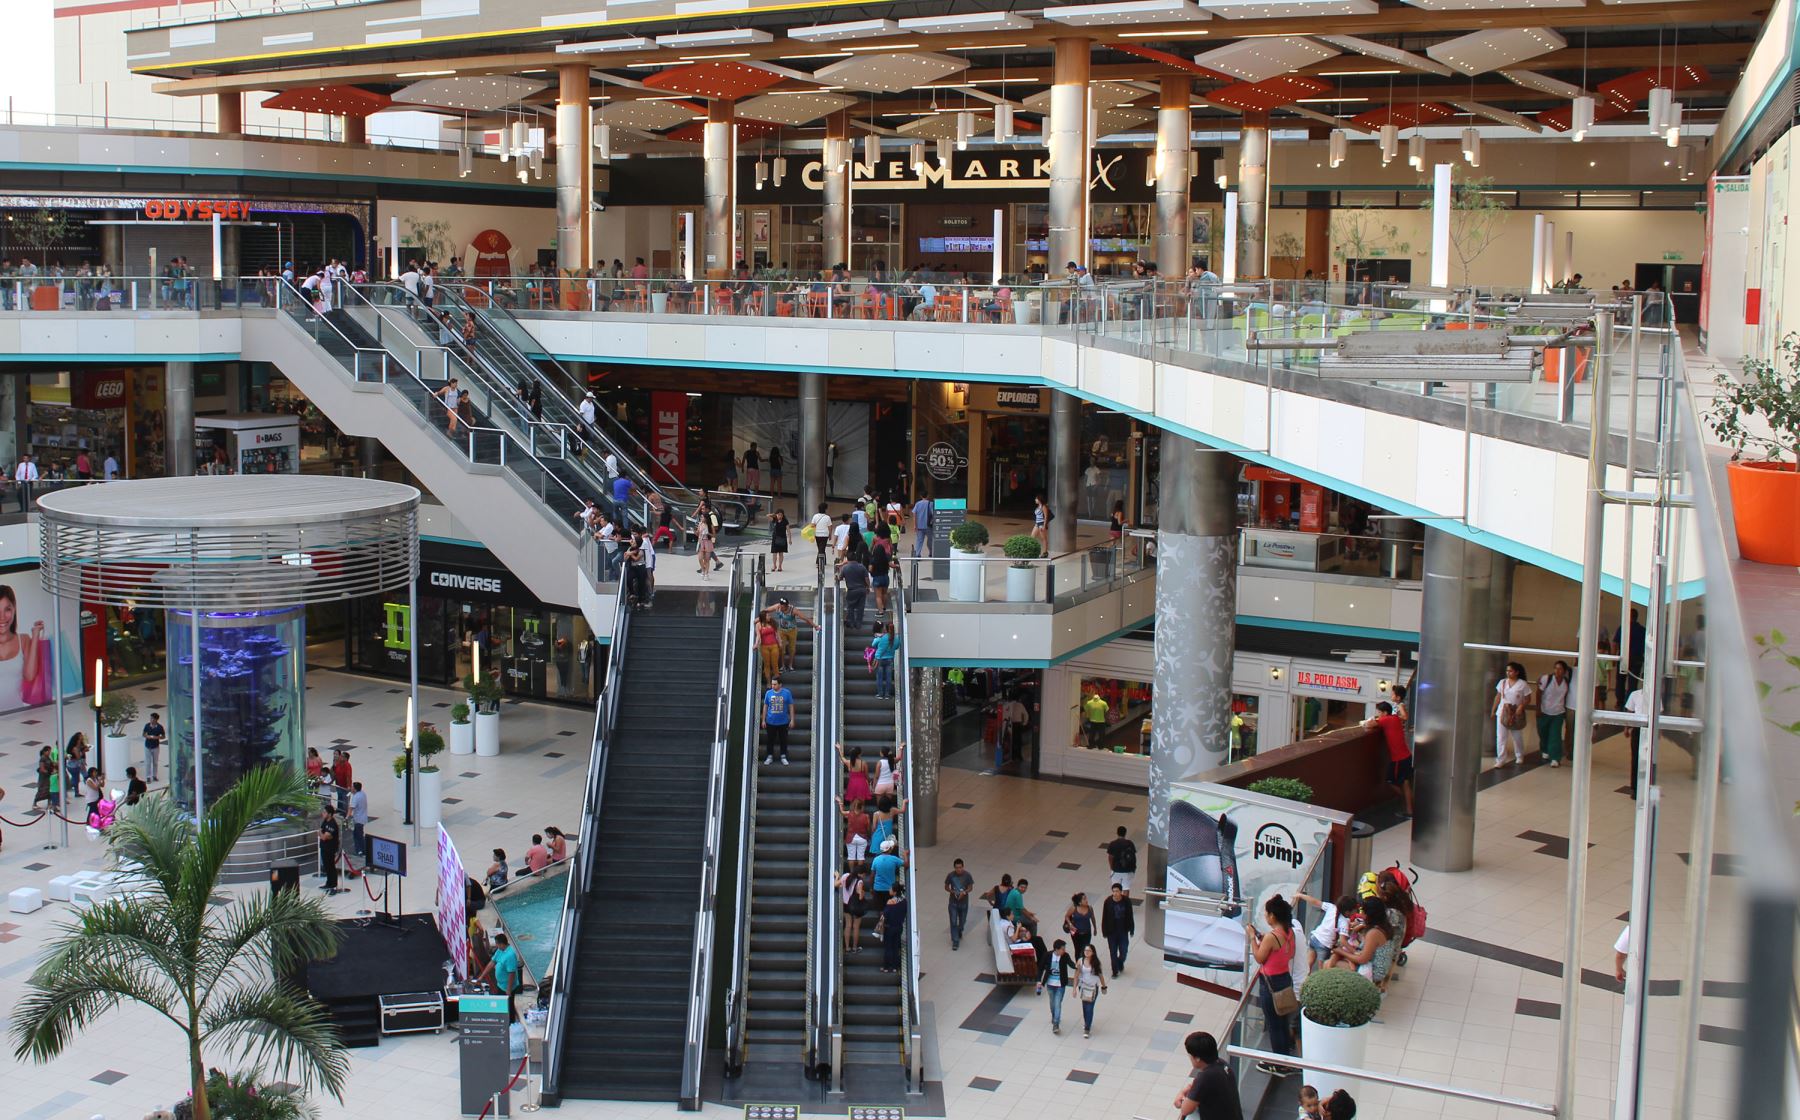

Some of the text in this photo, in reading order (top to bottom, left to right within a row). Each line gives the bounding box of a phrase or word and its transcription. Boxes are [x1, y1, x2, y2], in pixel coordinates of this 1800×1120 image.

[802, 158, 1052, 190] CNEMARK
[1726, 183, 1750, 192] SALIDA
[145, 200, 251, 219] ODYSSEY
[96, 381, 124, 398] LEGO
[996, 391, 1038, 404] EXPLORER
[658, 410, 679, 466] SALE
[932, 447, 953, 455] HASTA
[430, 572, 502, 593] CONVERSE
[1314, 673, 1334, 687] POLO
[1264, 834, 1282, 845] THE
[1253, 841, 1304, 869] pump
